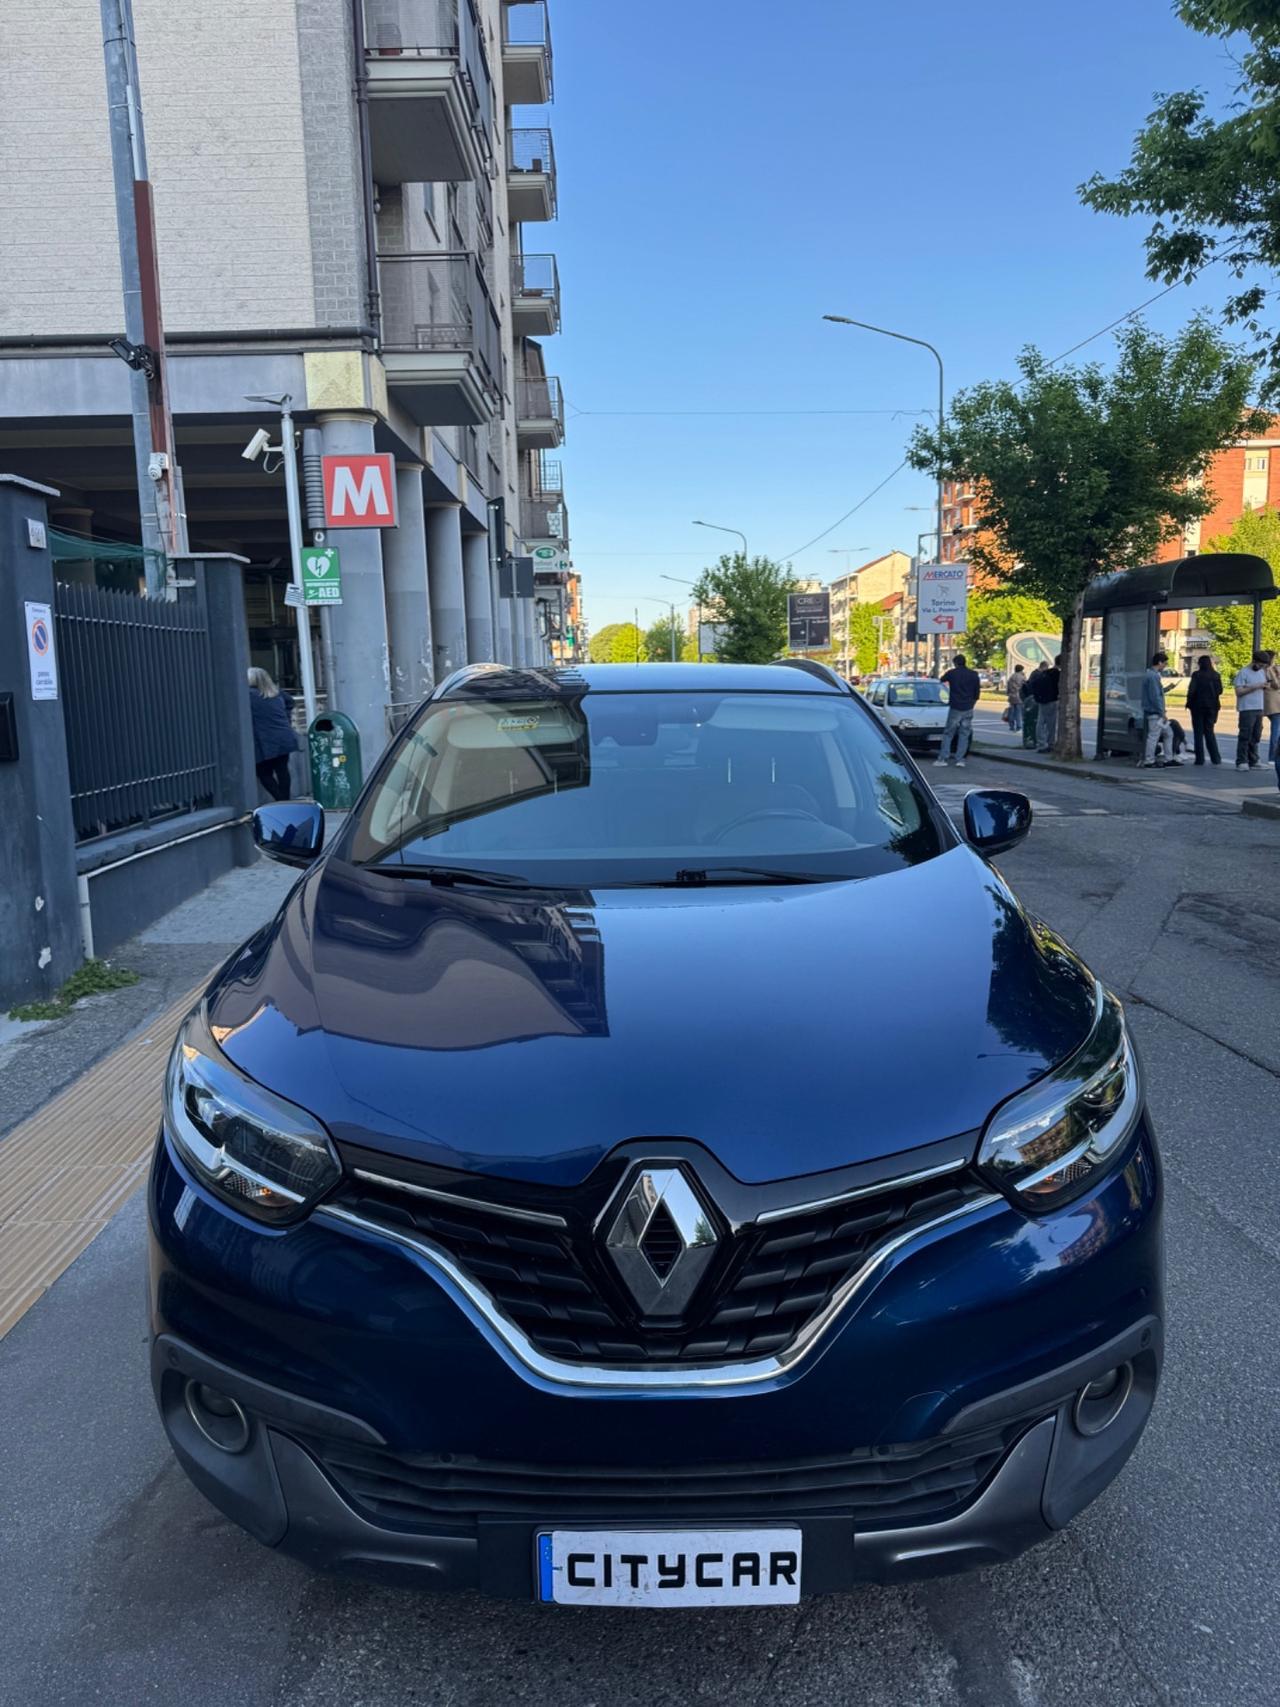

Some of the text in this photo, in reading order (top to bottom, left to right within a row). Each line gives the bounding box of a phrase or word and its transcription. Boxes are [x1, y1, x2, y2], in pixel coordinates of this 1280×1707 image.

[332, 465, 390, 517] M
[922, 570, 964, 580] MERCATO
[318, 587, 340, 598] AED
[567, 1551, 798, 1588] CITYCAR
